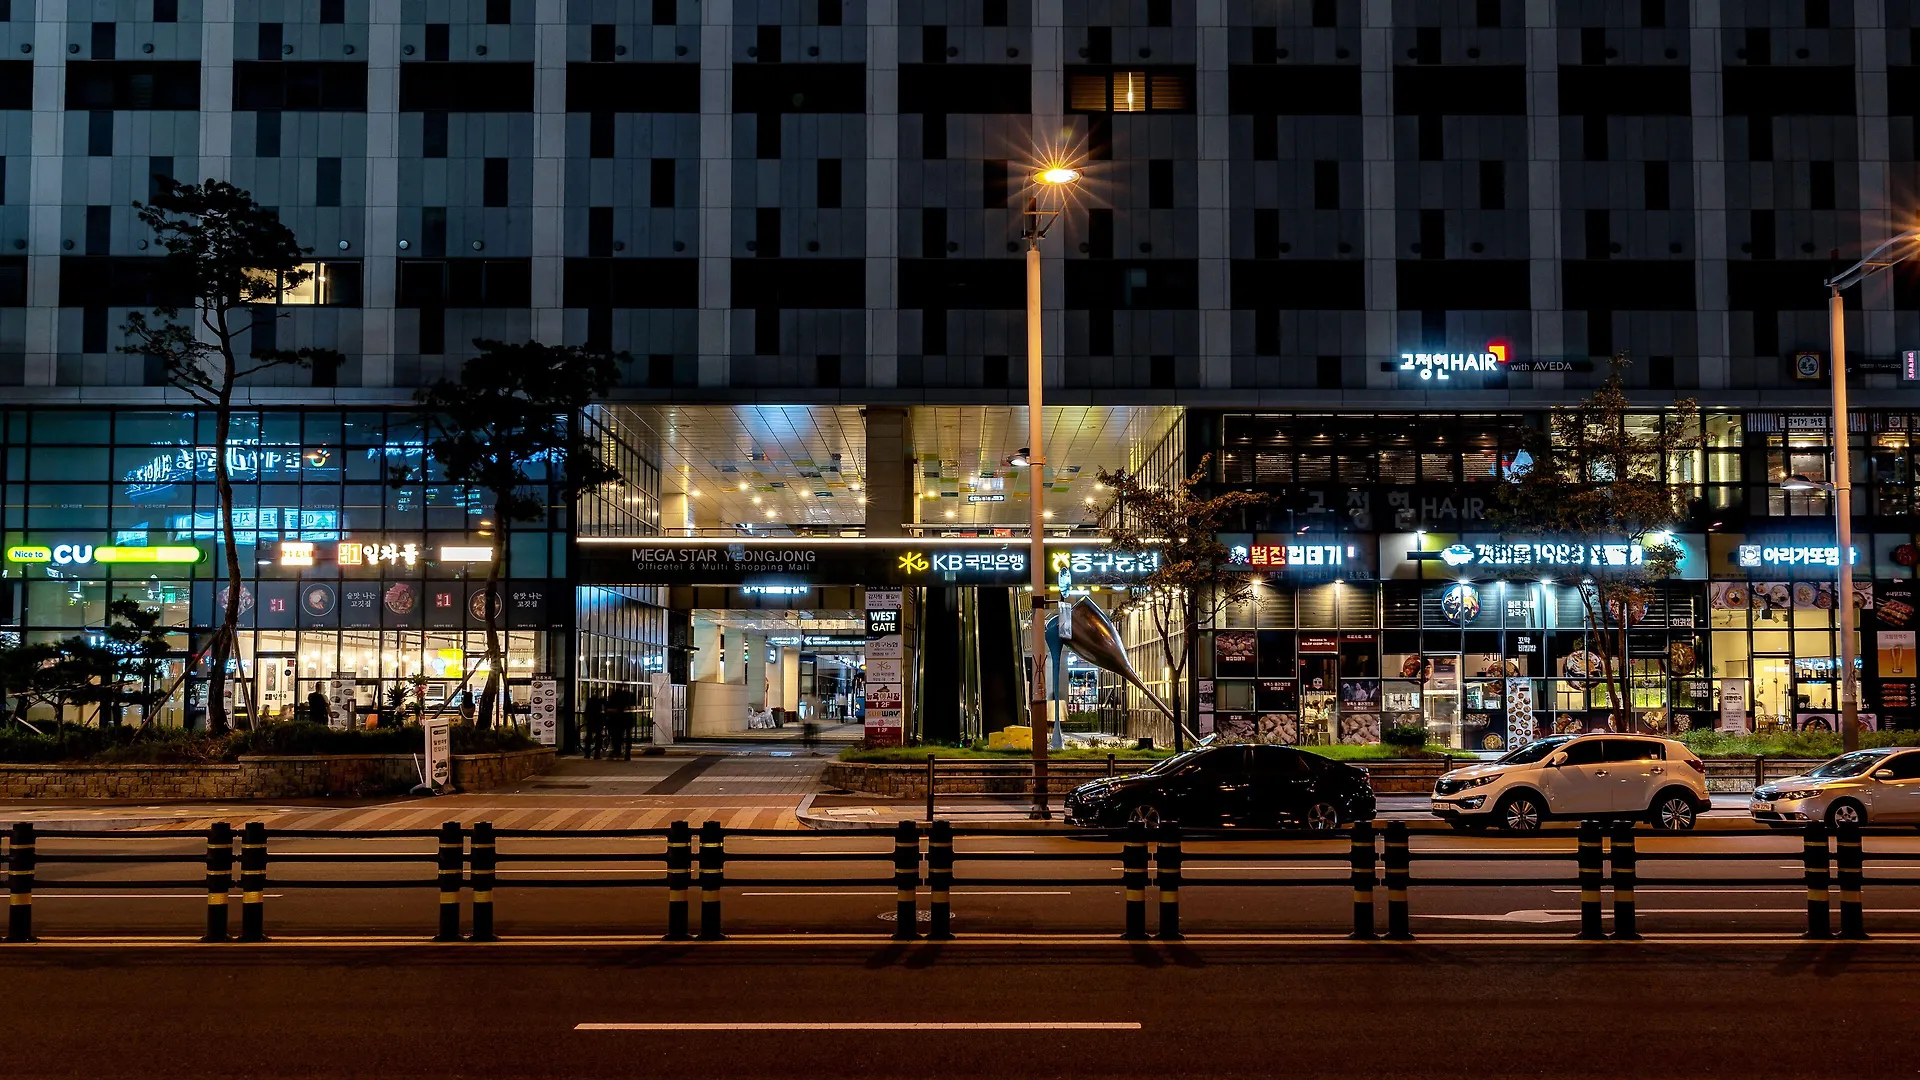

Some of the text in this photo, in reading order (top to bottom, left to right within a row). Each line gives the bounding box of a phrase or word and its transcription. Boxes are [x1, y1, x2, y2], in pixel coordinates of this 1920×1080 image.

[1510, 362, 1573, 371] with AVEDA
[14, 550, 44, 559] Nice to
[53, 545, 93, 564] CU
[632, 549, 816, 562] MEGA STAR YEONGJONG
[637, 562, 810, 572] Officetel & Multi Shopping Mall
[870, 611, 897, 621] WEST
[871, 622, 896, 632] GATE
